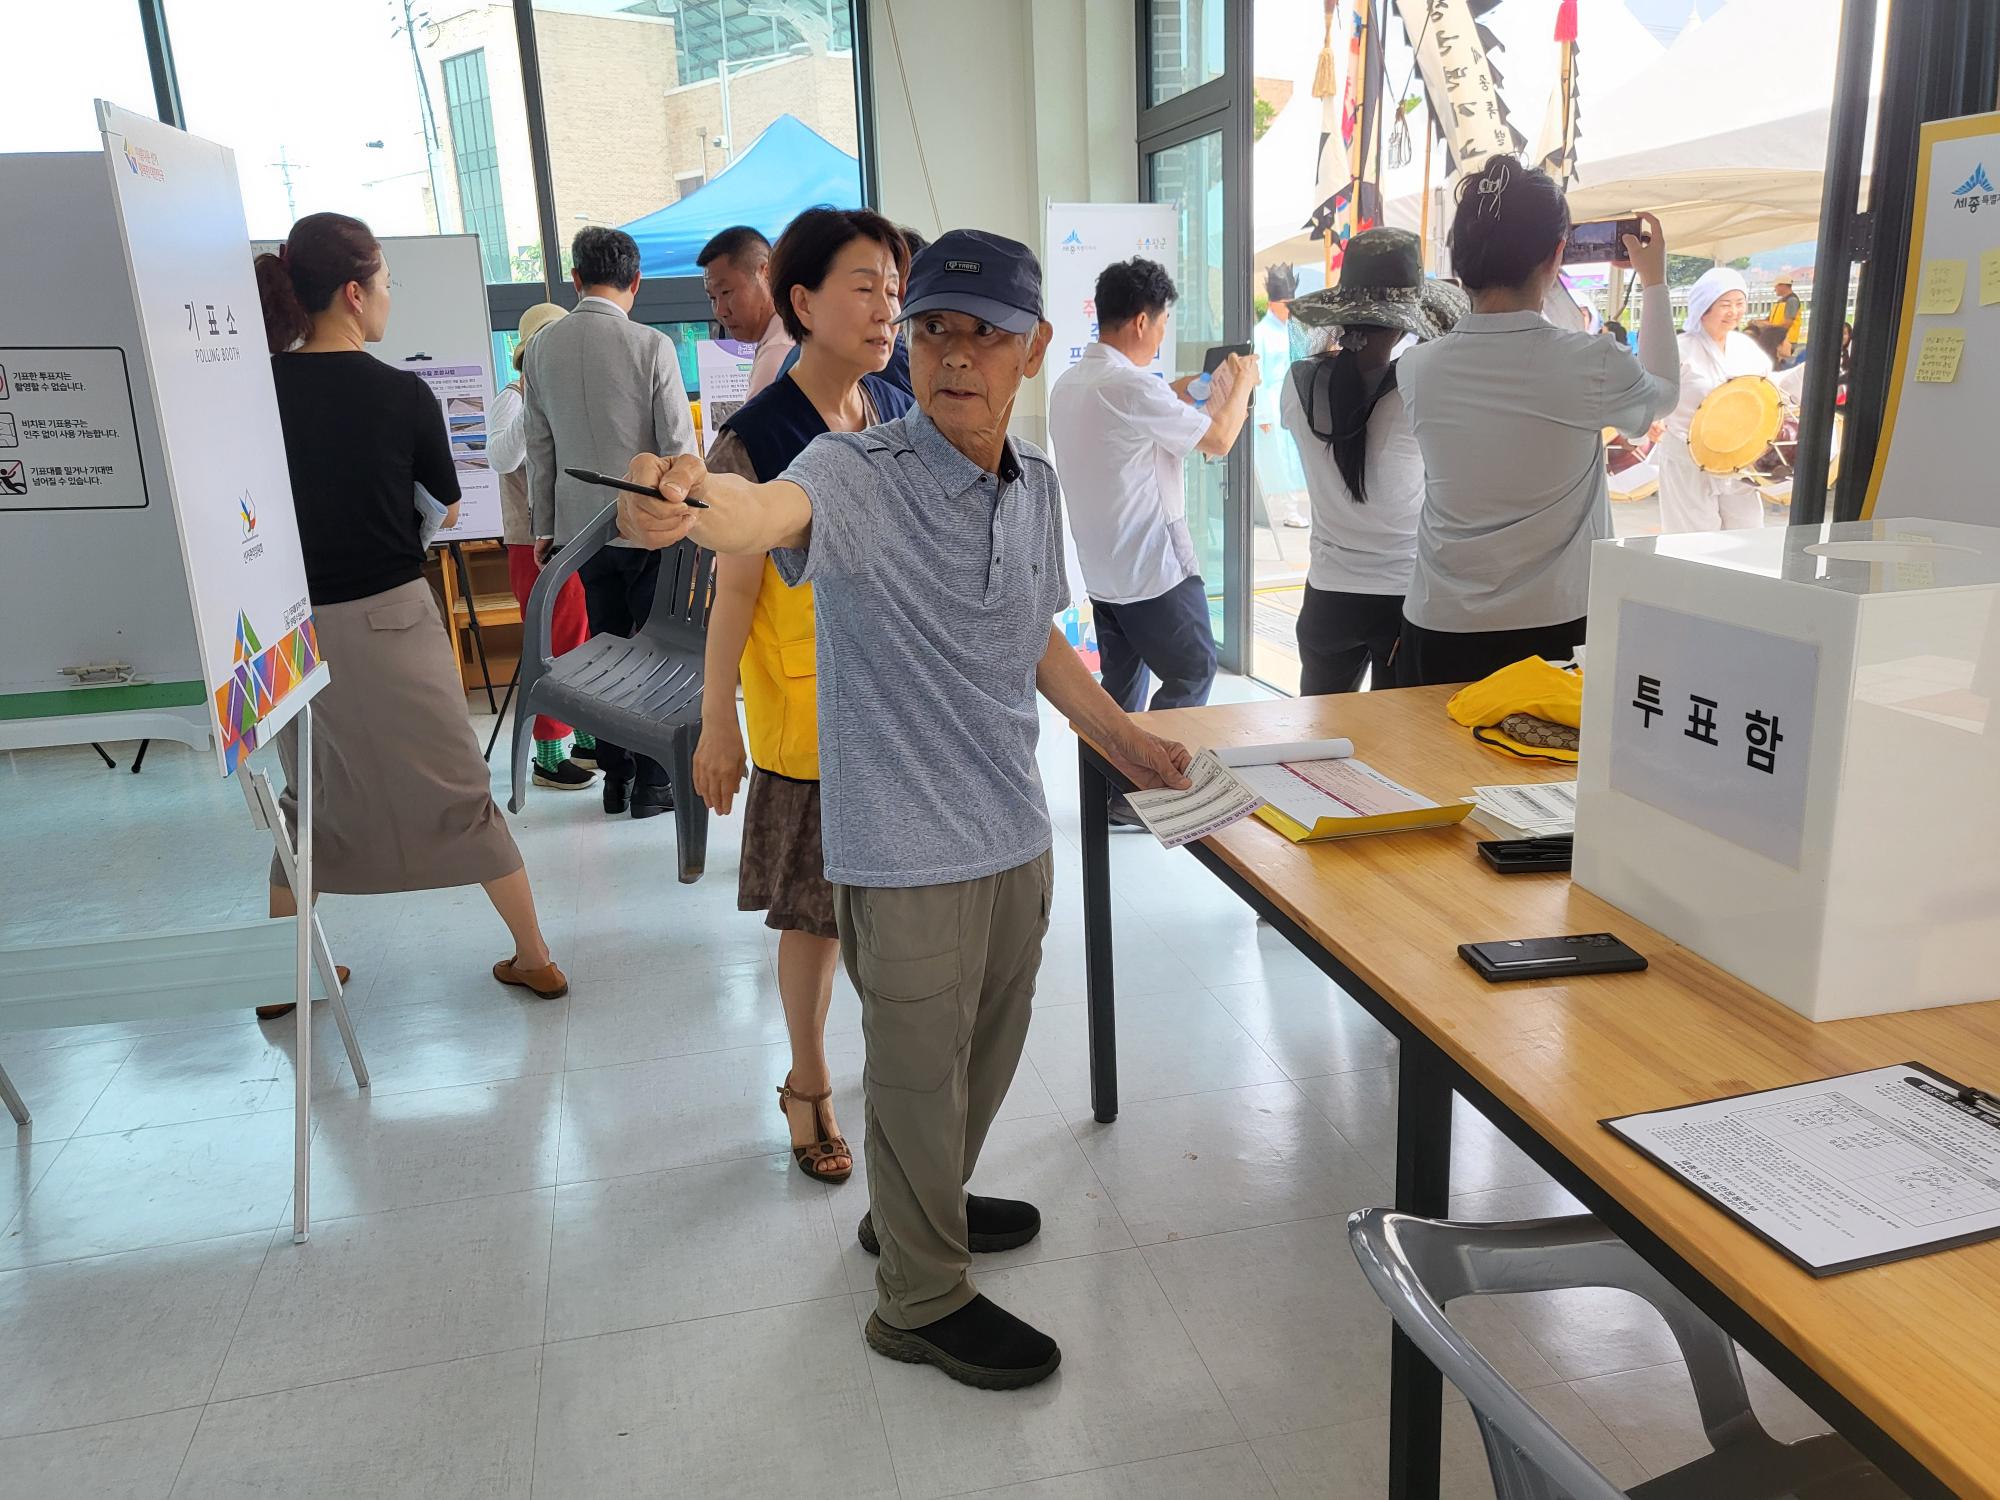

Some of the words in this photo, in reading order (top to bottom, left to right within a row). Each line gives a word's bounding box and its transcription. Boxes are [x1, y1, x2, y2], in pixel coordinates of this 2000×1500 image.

[184, 301, 238, 341] 기표소
[195, 348, 220, 363] POLLING
[221, 347, 240, 361] BOOTH
[13, 372, 37, 381] 기표한
[39, 372, 72, 381] 투표지는
[15, 382, 39, 392] 촬영할
[41, 383, 49, 391] 수
[51, 382, 86, 391] 없습니다.
[22, 419, 46, 429] 비치된
[48, 419, 88, 429] 기표용구는
[24, 430, 40, 439] 인주
[42, 430, 59, 439] 없이
[60, 430, 76, 439] 사용
[78, 429, 120, 438] 가능합니다.
[30, 466, 62, 476] 기표대를
[64, 466, 88, 475] 밀거나
[90, 466, 114, 475] 기대면
[32, 477, 57, 486] 넘어질
[58, 477, 66, 486] 수
[68, 476, 102, 485] 있습니다.
[1632, 674, 1783, 775] 투표함
